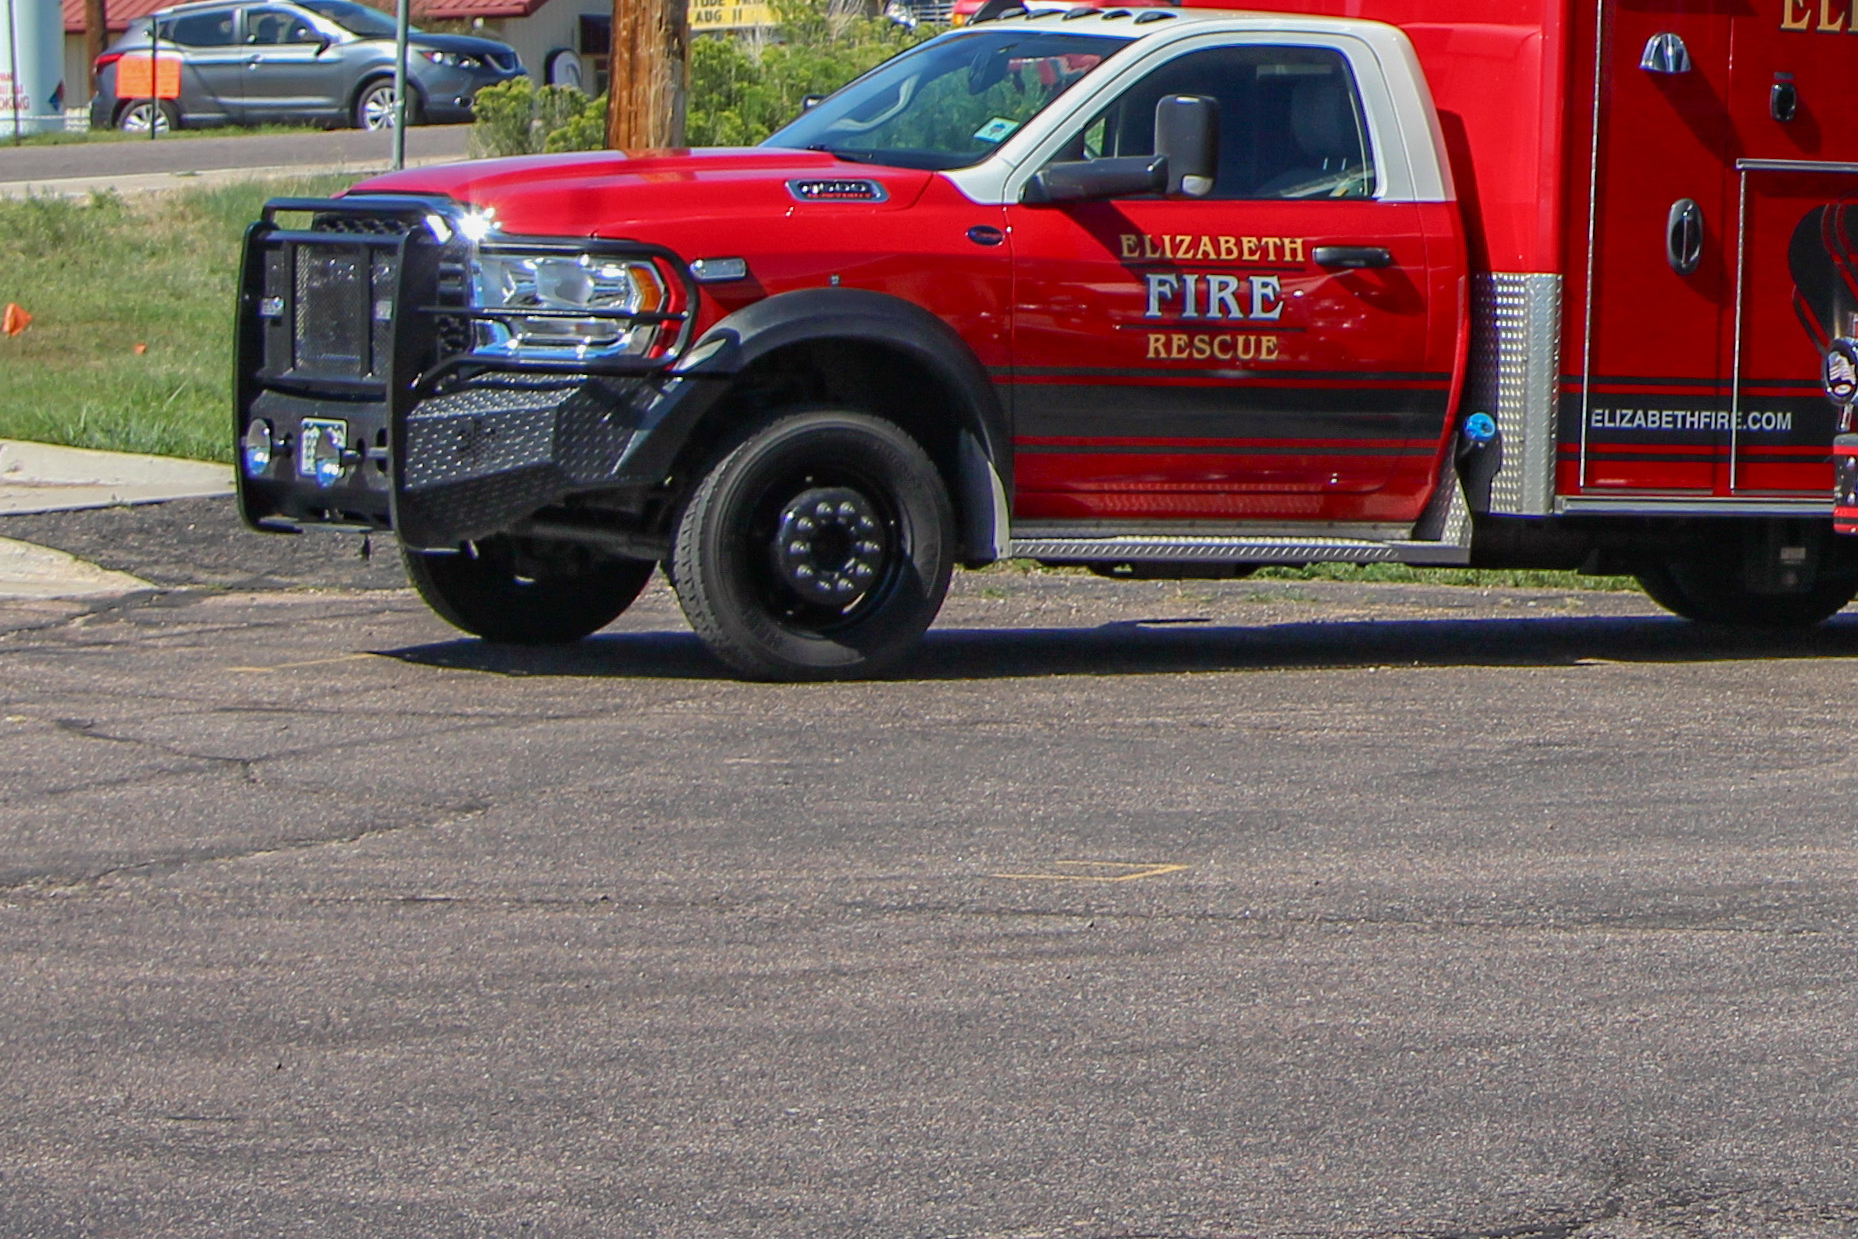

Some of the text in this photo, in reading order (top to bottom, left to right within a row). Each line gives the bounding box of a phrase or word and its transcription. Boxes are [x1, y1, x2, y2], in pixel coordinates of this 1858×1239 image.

[695, 9, 722, 23] AUG
[1120, 234, 1305, 262] ELIZABETH
[1144, 273, 1284, 321] FIRE
[1146, 333, 1279, 360] RESCUE
[1591, 409, 1792, 431] ELIZABETHFIRE.COM
